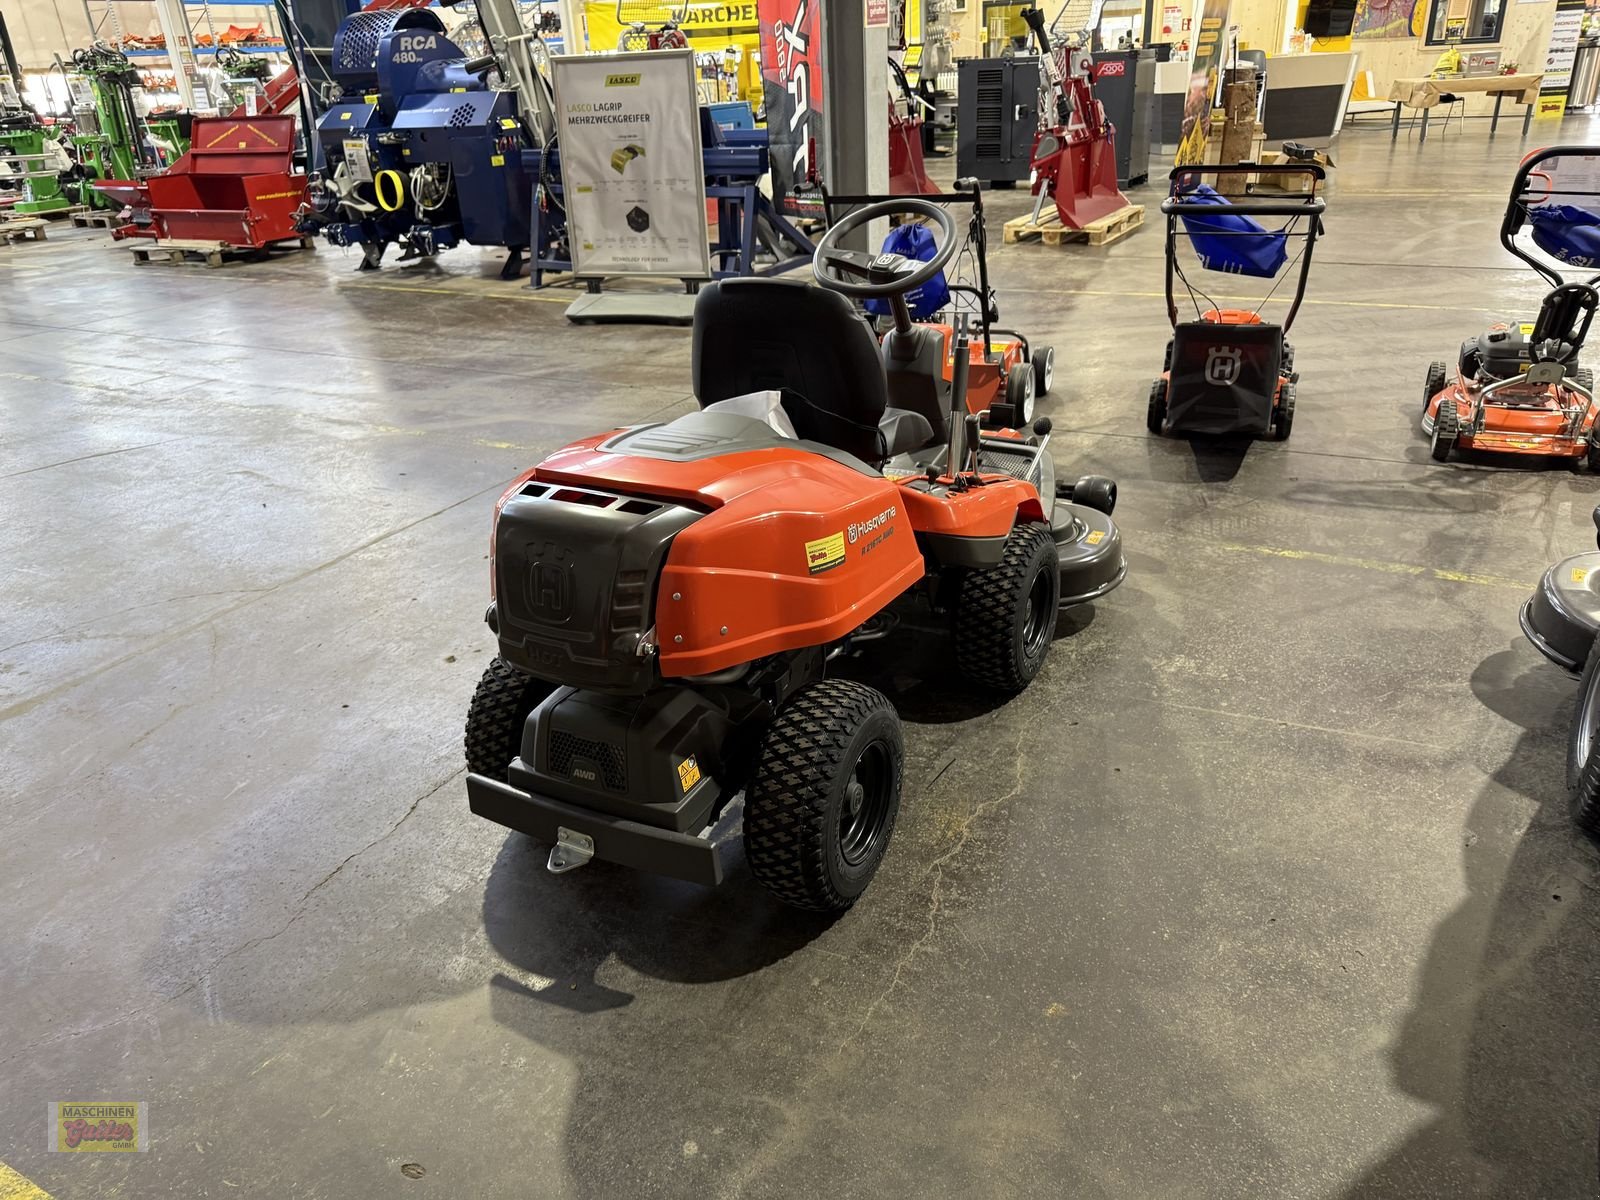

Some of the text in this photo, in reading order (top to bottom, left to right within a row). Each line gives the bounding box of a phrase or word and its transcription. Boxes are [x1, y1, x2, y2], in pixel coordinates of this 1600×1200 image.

[400, 35, 437, 51] RCA
[392, 51, 417, 64] 480
[567, 102, 623, 113] LASCO LAGRIP
[568, 113, 651, 125] MEHRZWECKGREIFER
[857, 505, 896, 538] Husqvarna
[573, 768, 595, 781] AWD
